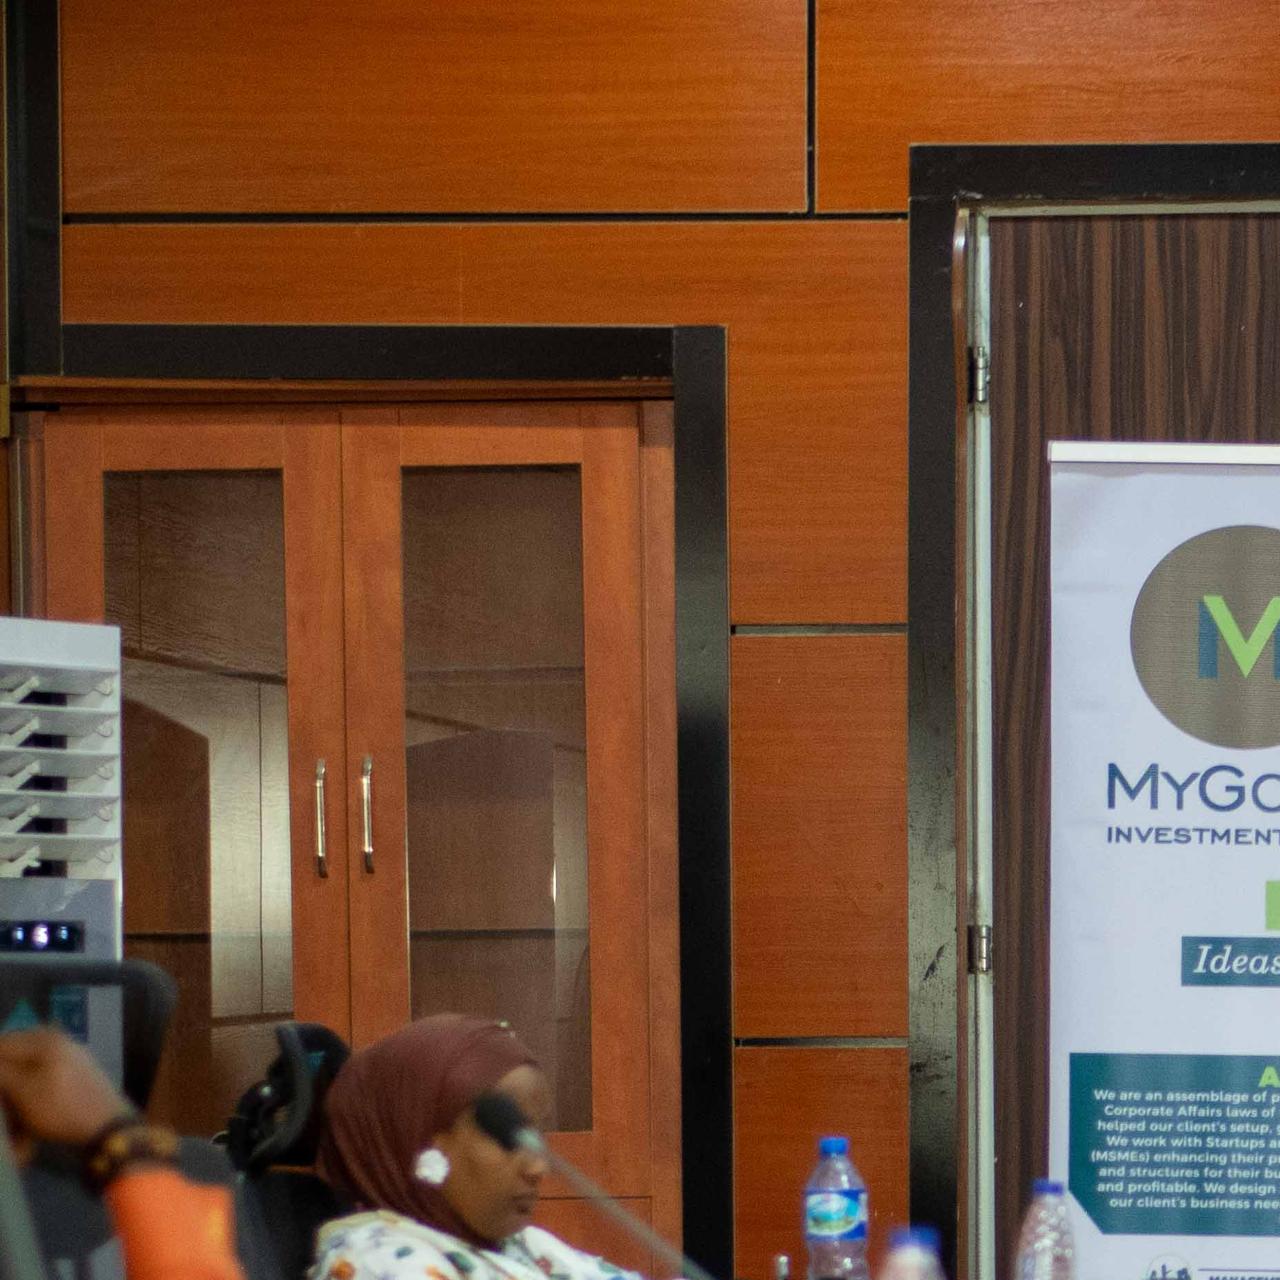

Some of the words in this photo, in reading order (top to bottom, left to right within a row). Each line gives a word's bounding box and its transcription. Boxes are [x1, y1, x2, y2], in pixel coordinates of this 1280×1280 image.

[1094, 1089, 1116, 1101] We
[1119, 1092, 1141, 1102] are
[1145, 1092, 1162, 1102] an
[1167, 1090, 1249, 1105] assemblage
[1253, 1091, 1267, 1103] of
[1104, 1104, 1173, 1119] Corporate
[1177, 1105, 1222, 1117] Affairs
[1226, 1106, 1257, 1118] laws
[1261, 1106, 1275, 1118] of
[1097, 1120, 1145, 1135] helped
[1150, 1123, 1173, 1133] our
[1177, 1121, 1226, 1133] client's
[1230, 1122, 1270, 1136] setup,
[1106, 1135, 1128, 1147] We
[1132, 1135, 1166, 1147] work
[1170, 1136, 1202, 1148] with
[1206, 1136, 1265, 1151] Startups
[1091, 1150, 1150, 1163] (MSMEs)
[1154, 1151, 1227, 1166] enhancing
[1231, 1152, 1264, 1164] their
[1099, 1165, 1125, 1177] and
[1129, 1166, 1200, 1178] structures
[1203, 1167, 1223, 1179] for
[1227, 1167, 1260, 1179] their
[1097, 1181, 1124, 1193] and
[1128, 1181, 1200, 1196] profitable.
[1203, 1182, 1226, 1194] We
[1229, 1182, 1275, 1197] design
[1109, 1198, 1132, 1208] our
[1137, 1197, 1186, 1209] client's
[1190, 1197, 1250, 1210] business
